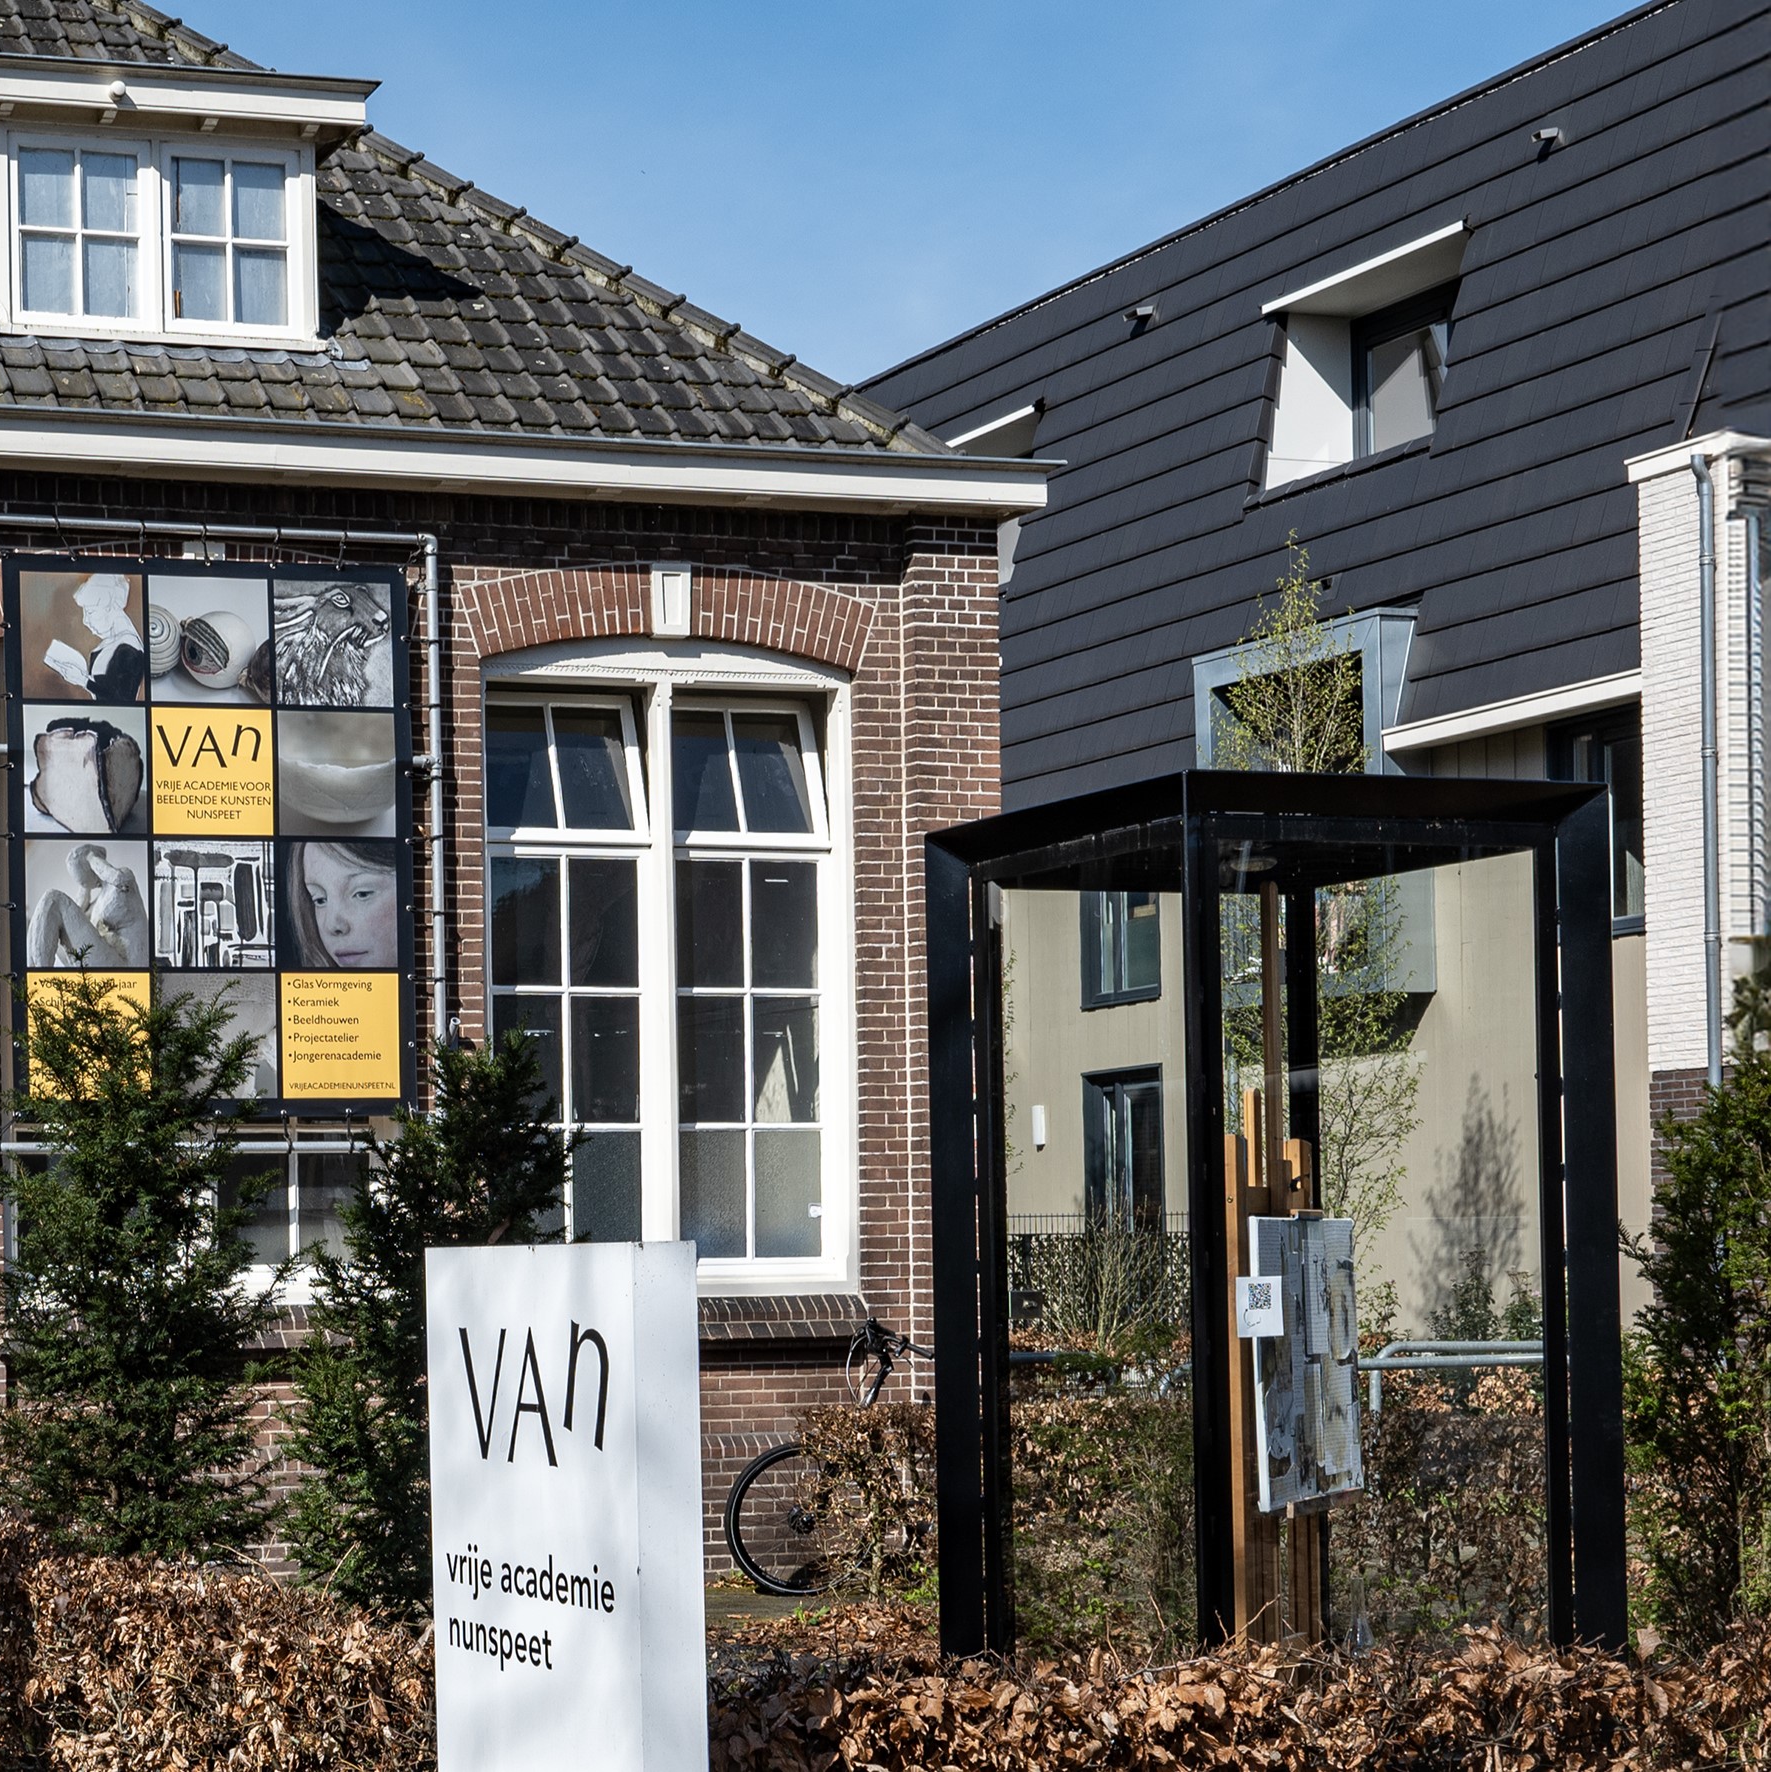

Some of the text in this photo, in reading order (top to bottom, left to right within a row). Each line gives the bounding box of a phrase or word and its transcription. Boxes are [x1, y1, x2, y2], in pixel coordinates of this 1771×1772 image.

[156, 780, 272, 792] VRIJE ACADEMIE VOOR
[156, 794, 271, 806] BEELDENDE KUNSTEN
[186, 810, 242, 820] NUNSPEET
[292, 978, 373, 992] Glas Vormgeving
[292, 997, 340, 1007] Keramiek
[293, 1014, 359, 1025] Beeldhouwen
[293, 1032, 360, 1045] Projectatelier
[292, 1050, 382, 1063] Jongerenacademie
[289, 1081, 396, 1091] VRIJEACADEMIENUNSPEET.NL
[446, 1543, 616, 1614] vrije academie
[449, 1616, 553, 1672] nunspeet
